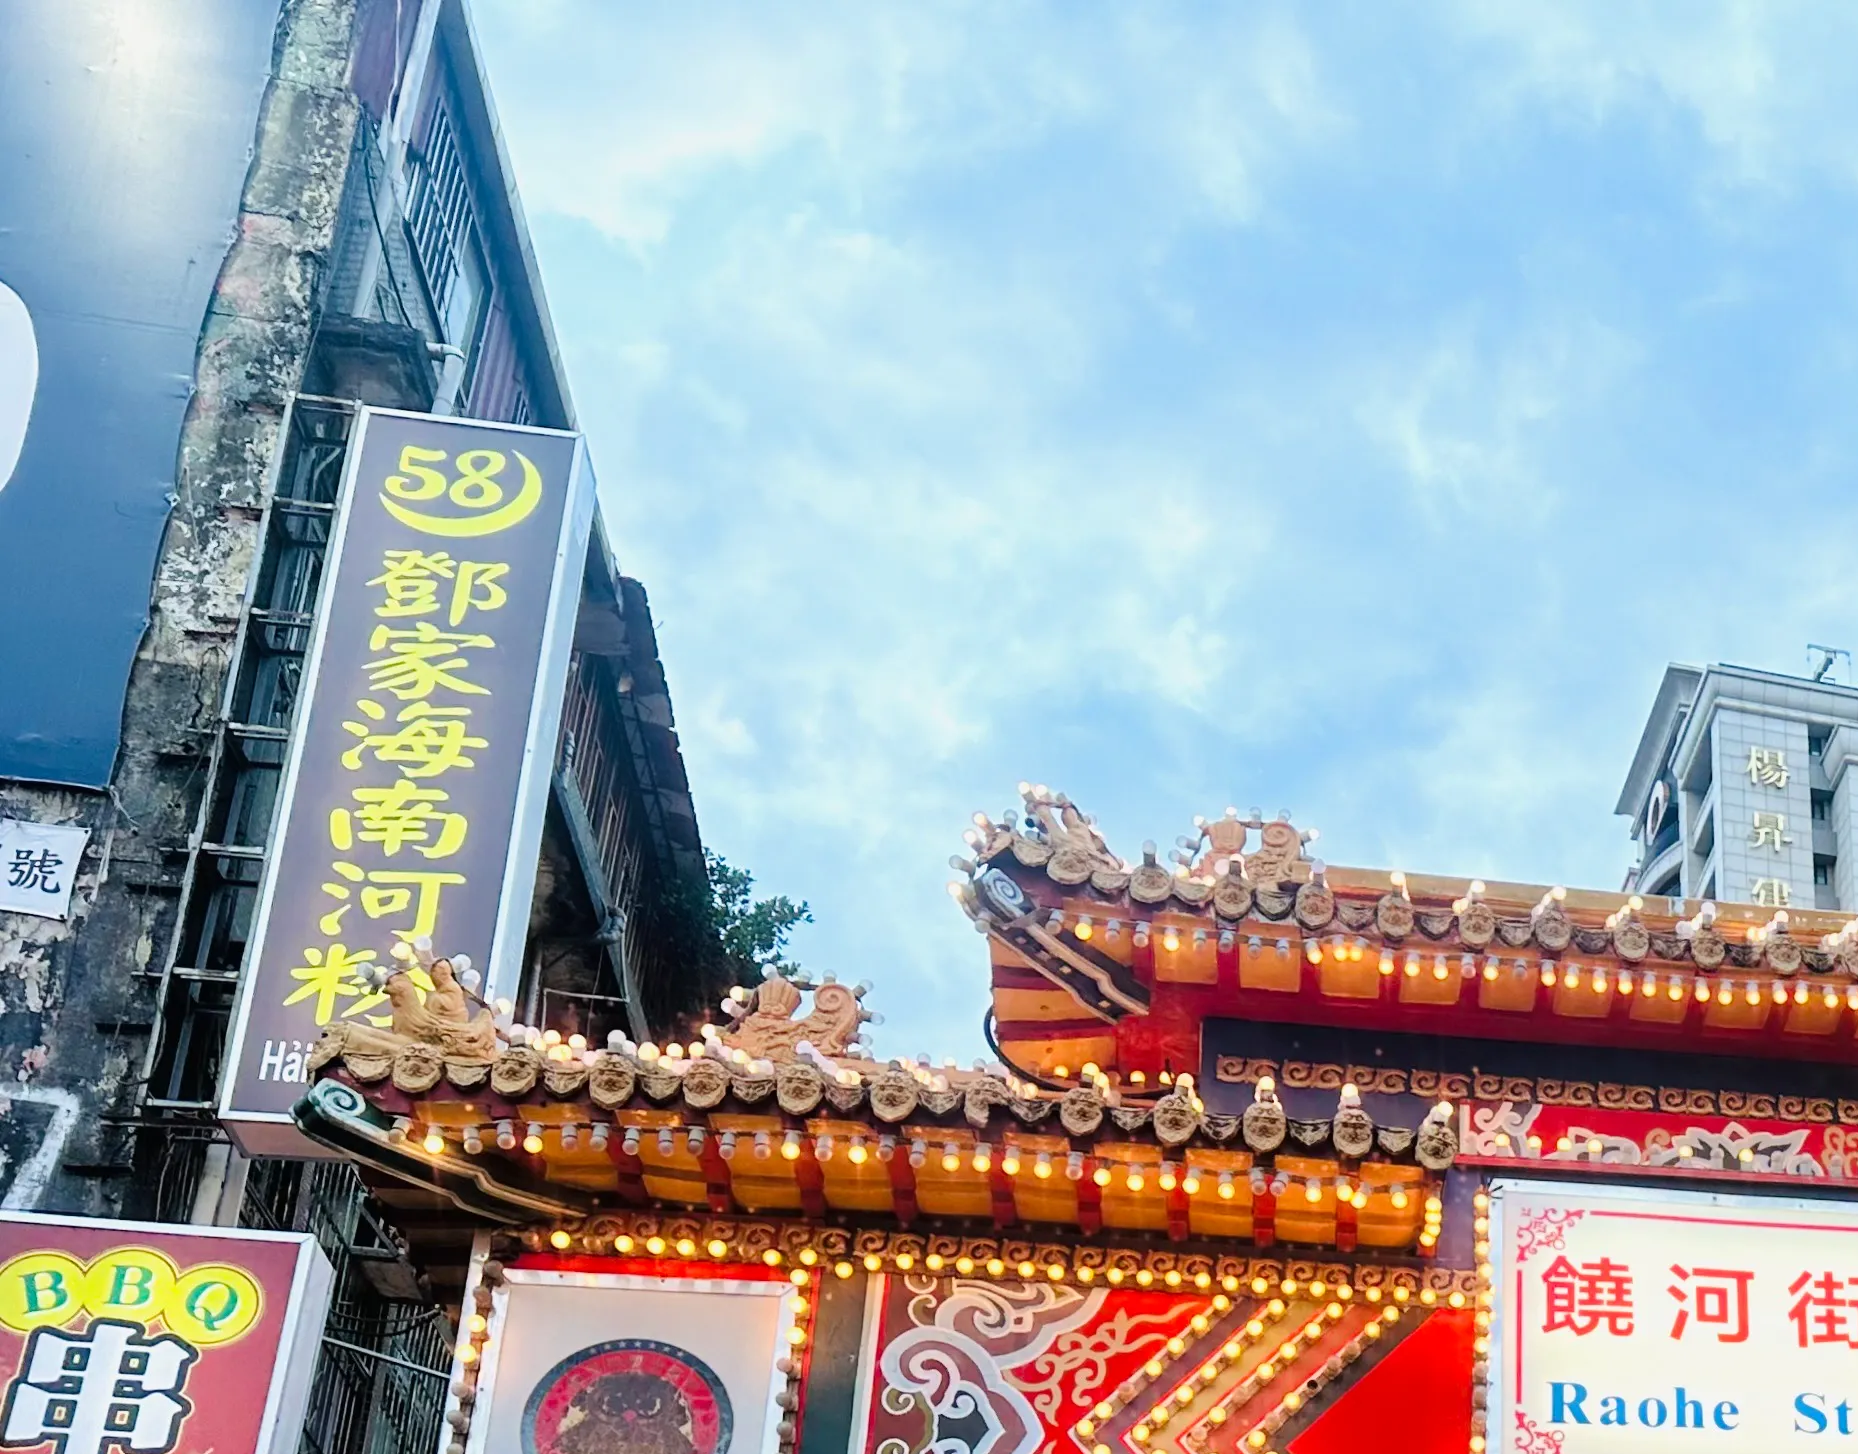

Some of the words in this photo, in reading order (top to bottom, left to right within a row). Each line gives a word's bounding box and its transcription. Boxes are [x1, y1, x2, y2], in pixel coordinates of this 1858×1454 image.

[384, 447, 507, 509] 58
[283, 549, 509, 1027] 鄧家海南河粉
[8, 847, 61, 895] 號
[22, 1264, 239, 1334] BBQ
[1546, 1380, 1740, 1432] Raohe
